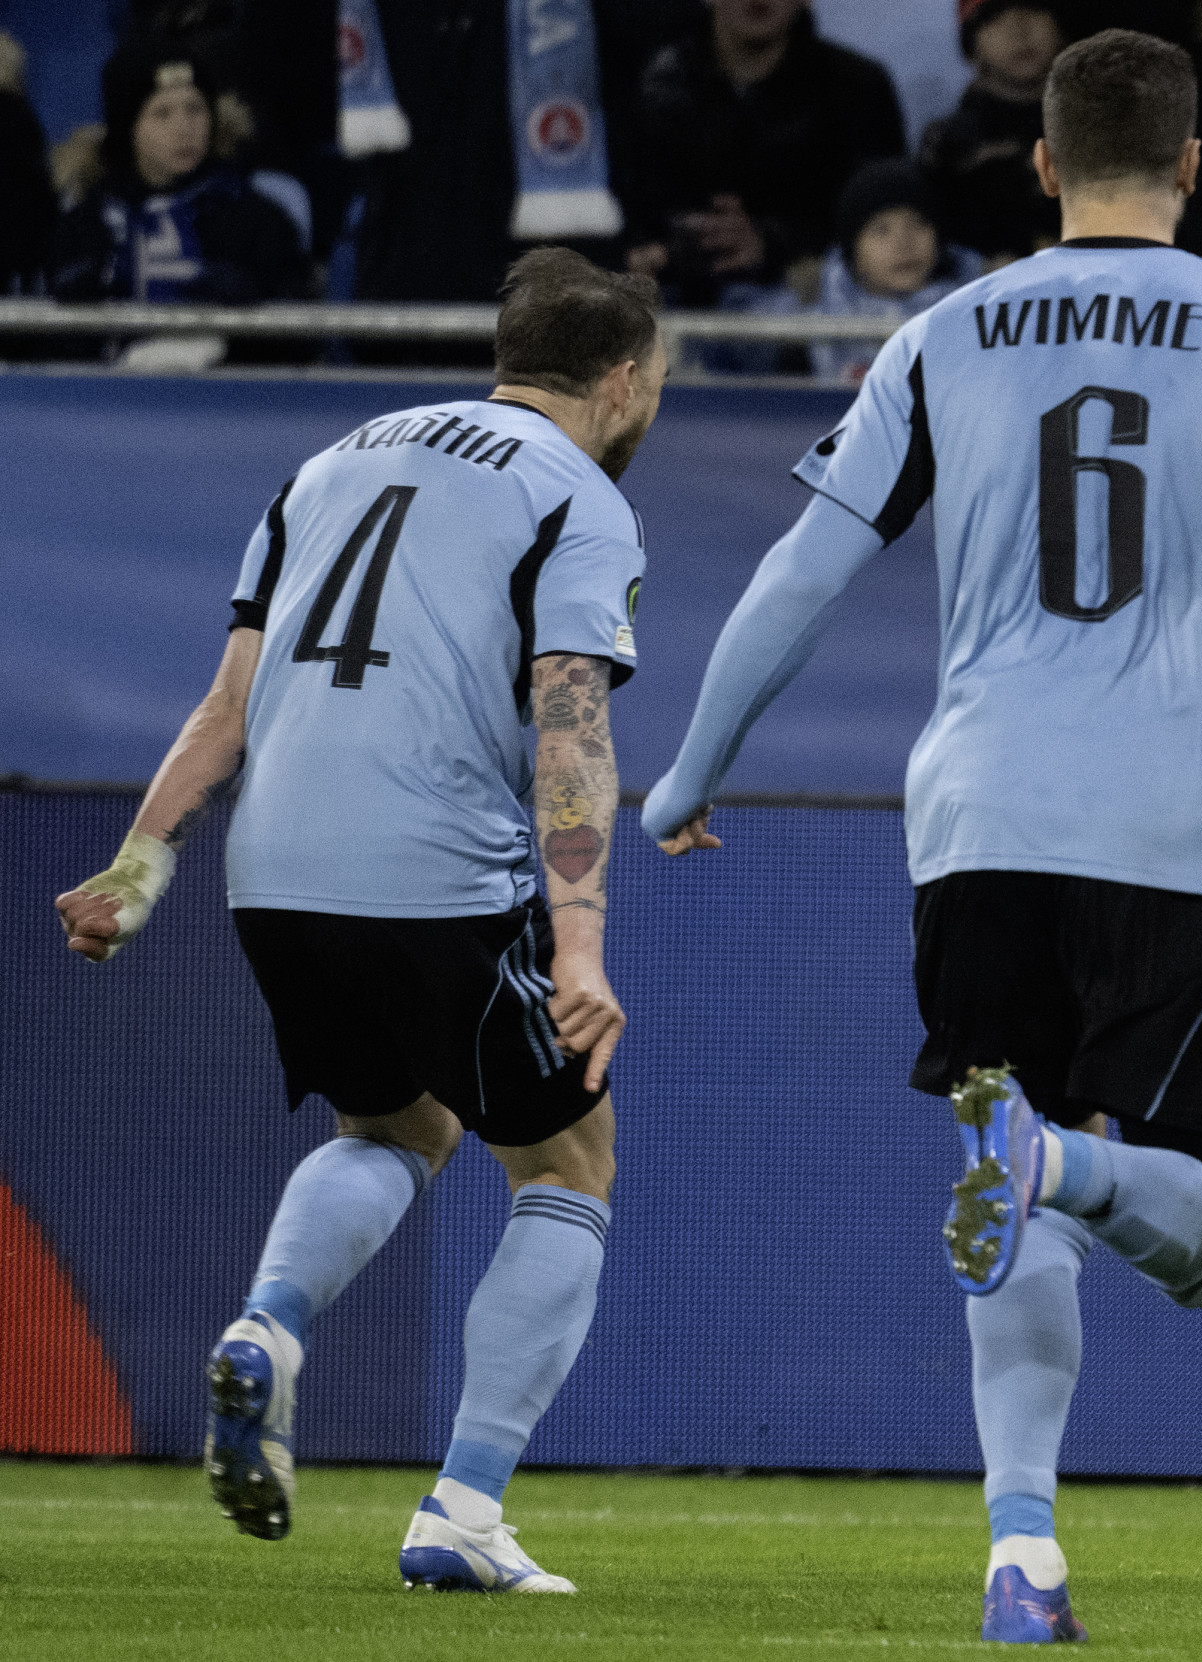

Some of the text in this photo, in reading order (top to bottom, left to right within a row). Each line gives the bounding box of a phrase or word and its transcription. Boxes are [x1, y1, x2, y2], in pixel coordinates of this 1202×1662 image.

[336, 411, 524, 472] KASHIA
[1038, 385, 1149, 623] 6
[292, 485, 419, 690] 4
